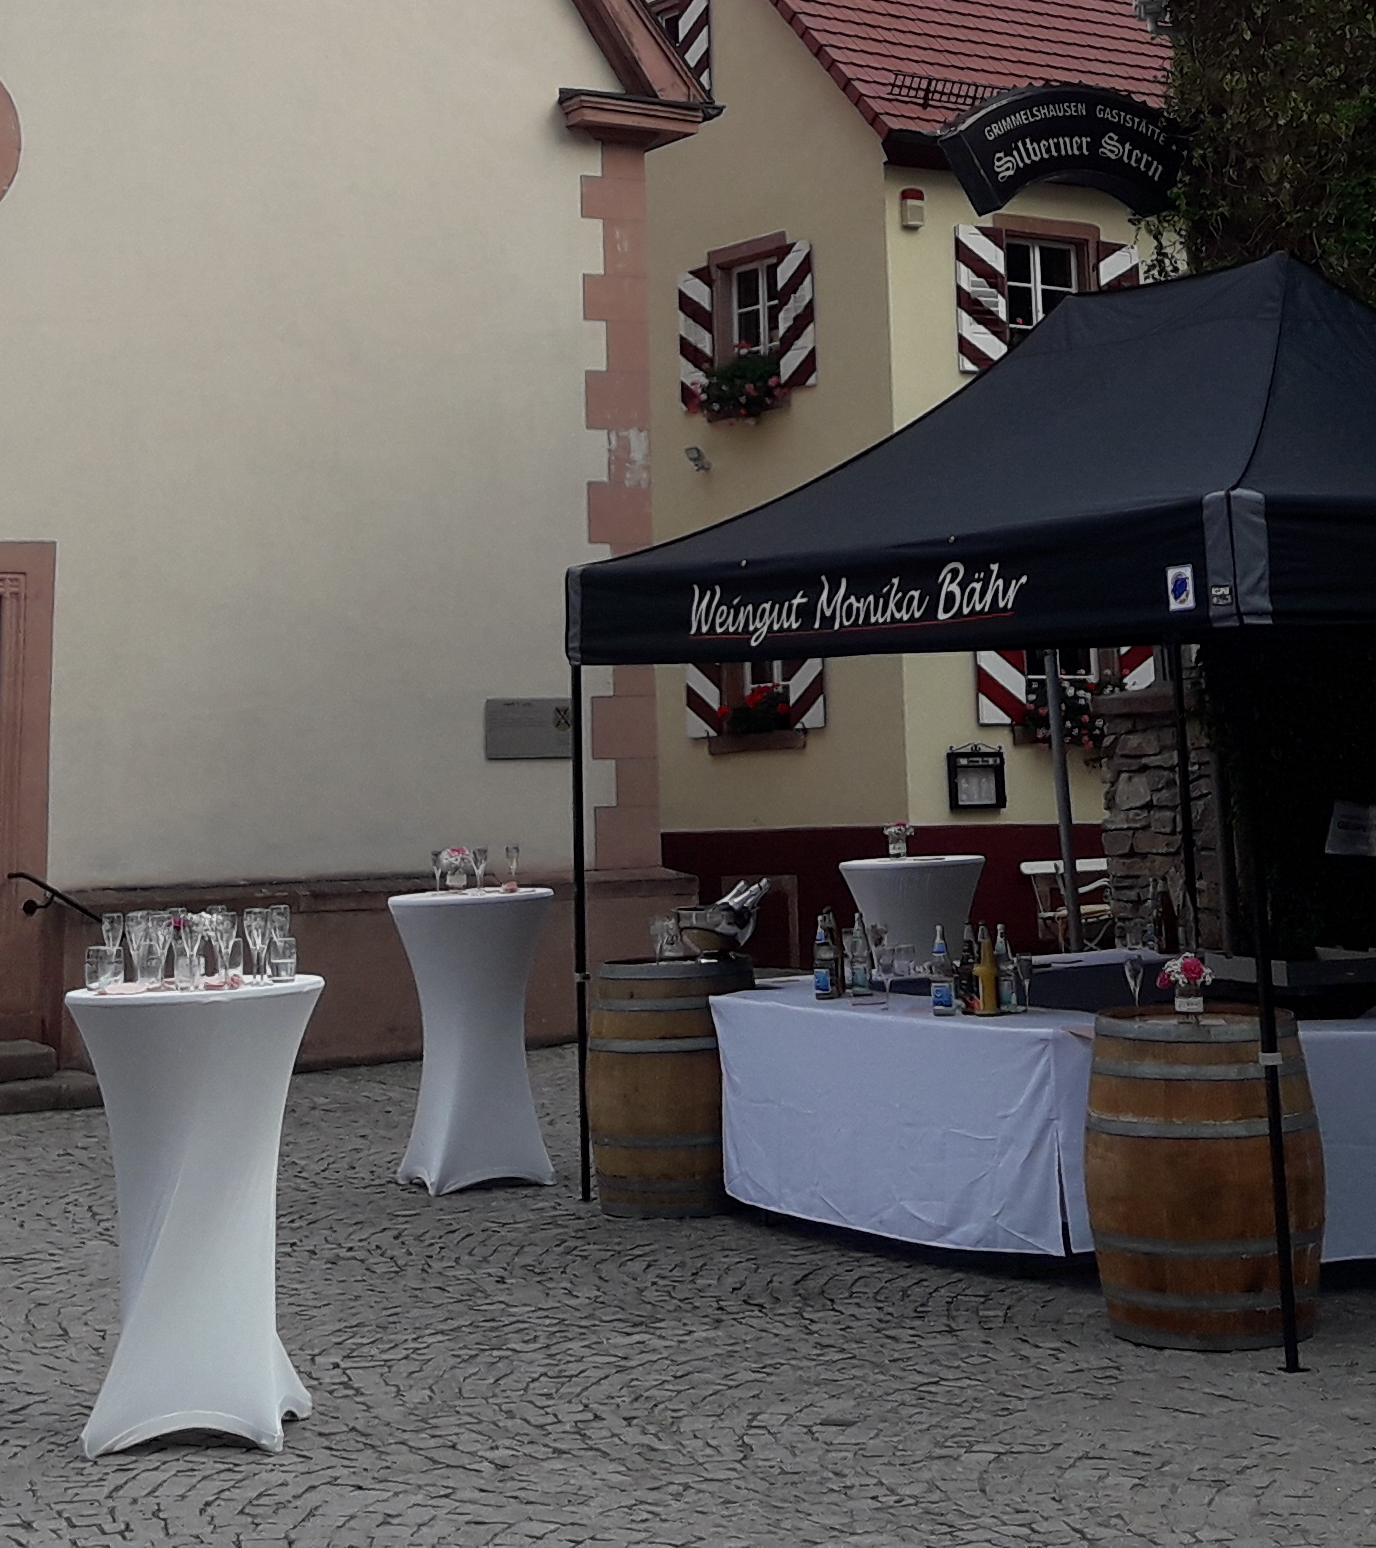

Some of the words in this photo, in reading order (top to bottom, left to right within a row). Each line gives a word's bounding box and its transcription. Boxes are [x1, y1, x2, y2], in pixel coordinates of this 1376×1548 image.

[984, 102, 1087, 141] GRIMMELSHAUSEN
[1095, 104, 1167, 145] GASTSTÄTTE
[993, 135, 1092, 182] Silberner
[1098, 132, 1165, 182] Stern
[690, 583, 809, 647] Weingut
[812, 574, 931, 630] Monika
[936, 561, 1028, 620] Bähr
